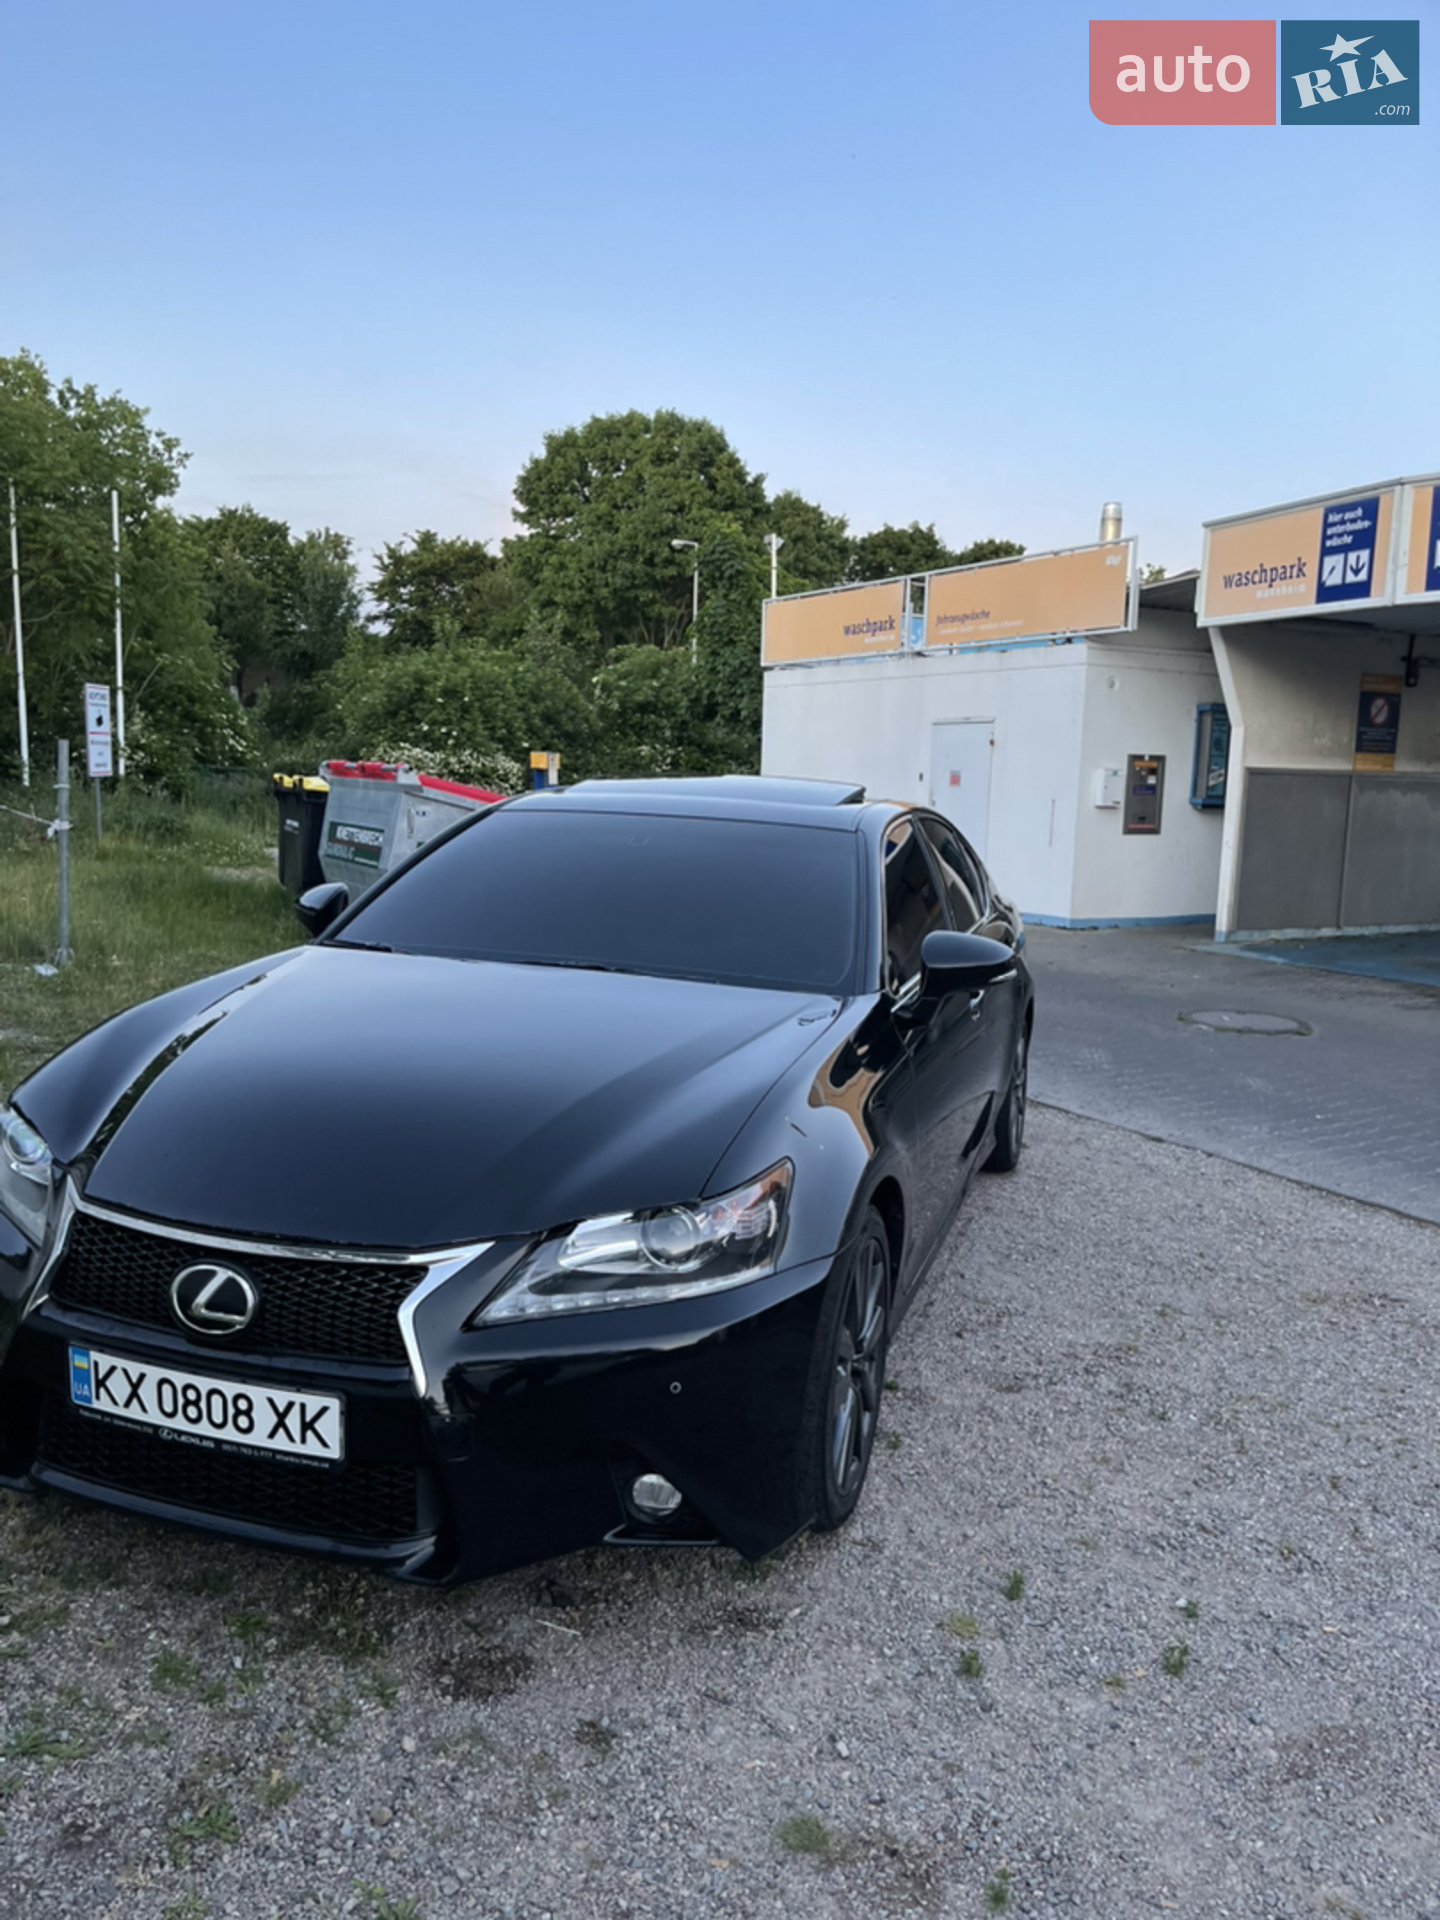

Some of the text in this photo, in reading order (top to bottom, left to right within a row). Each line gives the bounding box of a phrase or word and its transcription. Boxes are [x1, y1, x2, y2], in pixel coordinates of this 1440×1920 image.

[1222, 557, 1307, 589] waschpark
[843, 615, 896, 637] waschpark
[73, 1382, 90, 1397] UA
[93, 1360, 148, 1413] KX
[157, 1377, 255, 1435] 0808
[266, 1396, 331, 1449] XK
[174, 1432, 215, 1448] LEXUS
